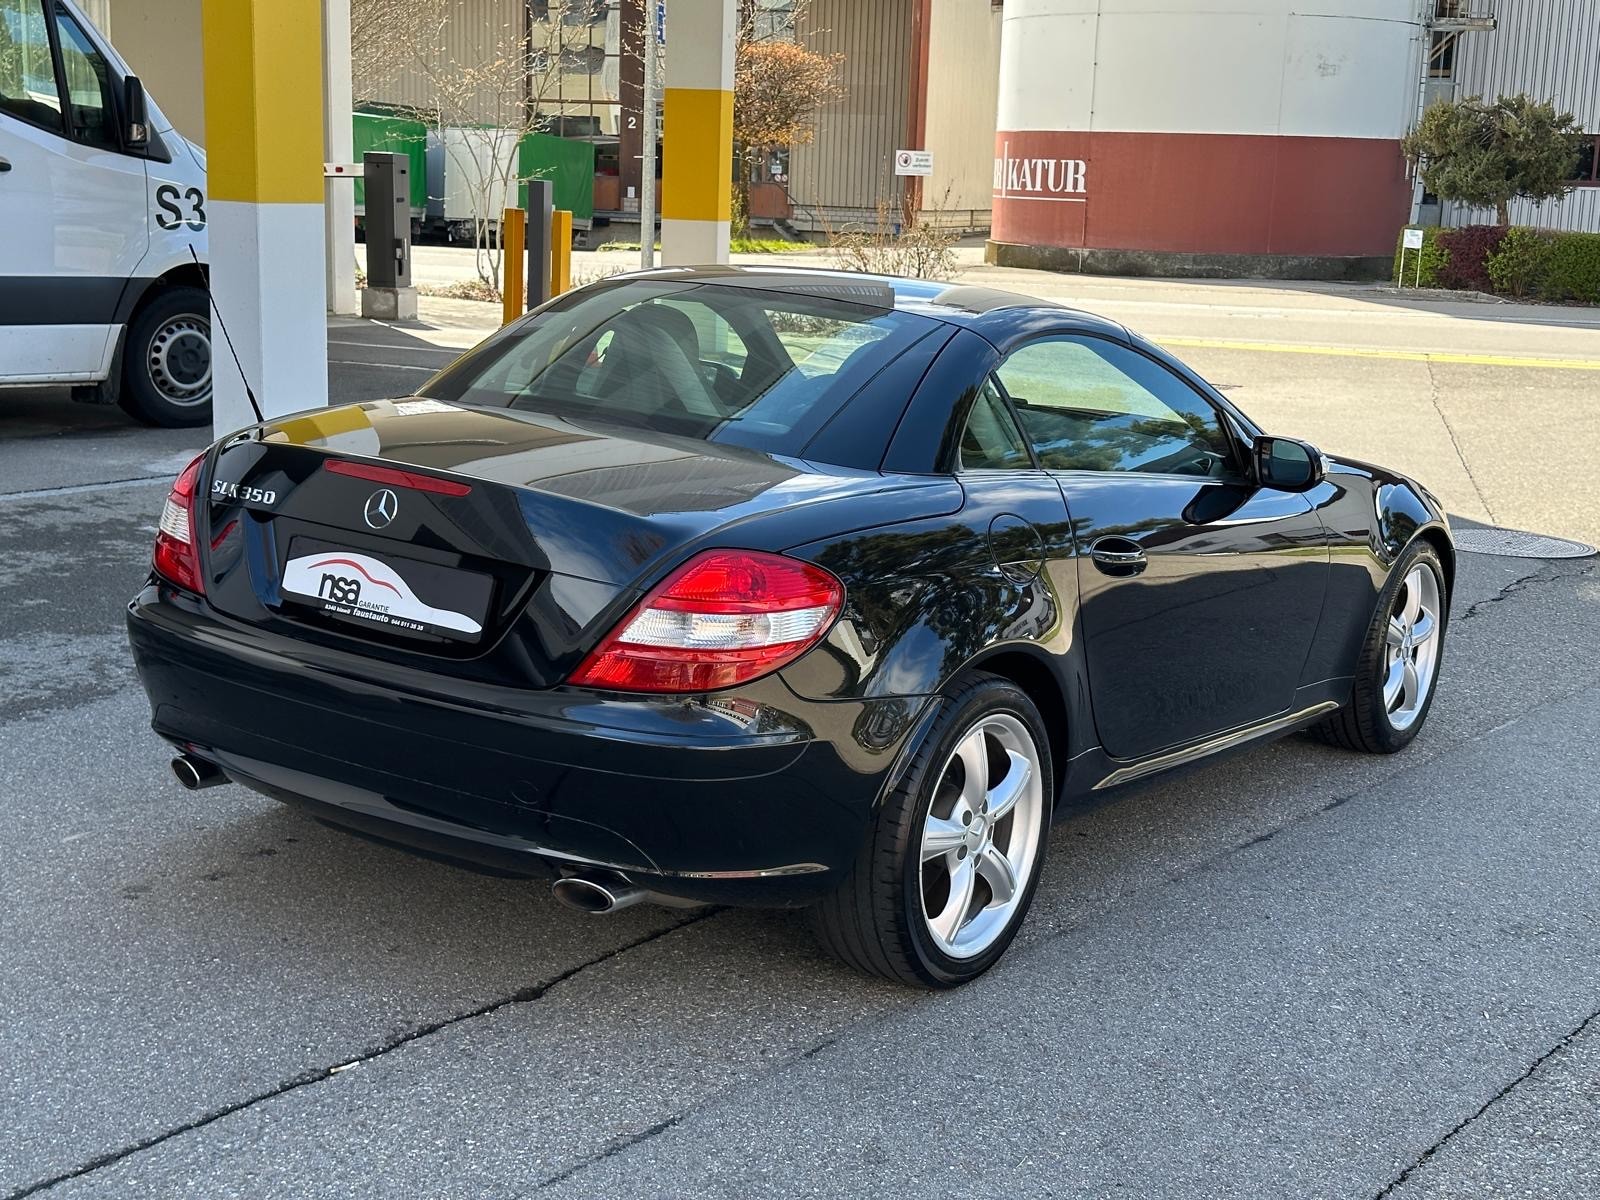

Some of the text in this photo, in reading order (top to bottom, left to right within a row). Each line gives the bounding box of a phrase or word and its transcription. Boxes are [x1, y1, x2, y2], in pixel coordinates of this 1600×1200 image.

[628, 117, 637, 129] 2
[155, 184, 206, 232] S3
[211, 479, 276, 505] SLK 350
[318, 573, 361, 605] nsa
[353, 608, 389, 623] faustauto
[358, 600, 390, 613] GARANTIE
